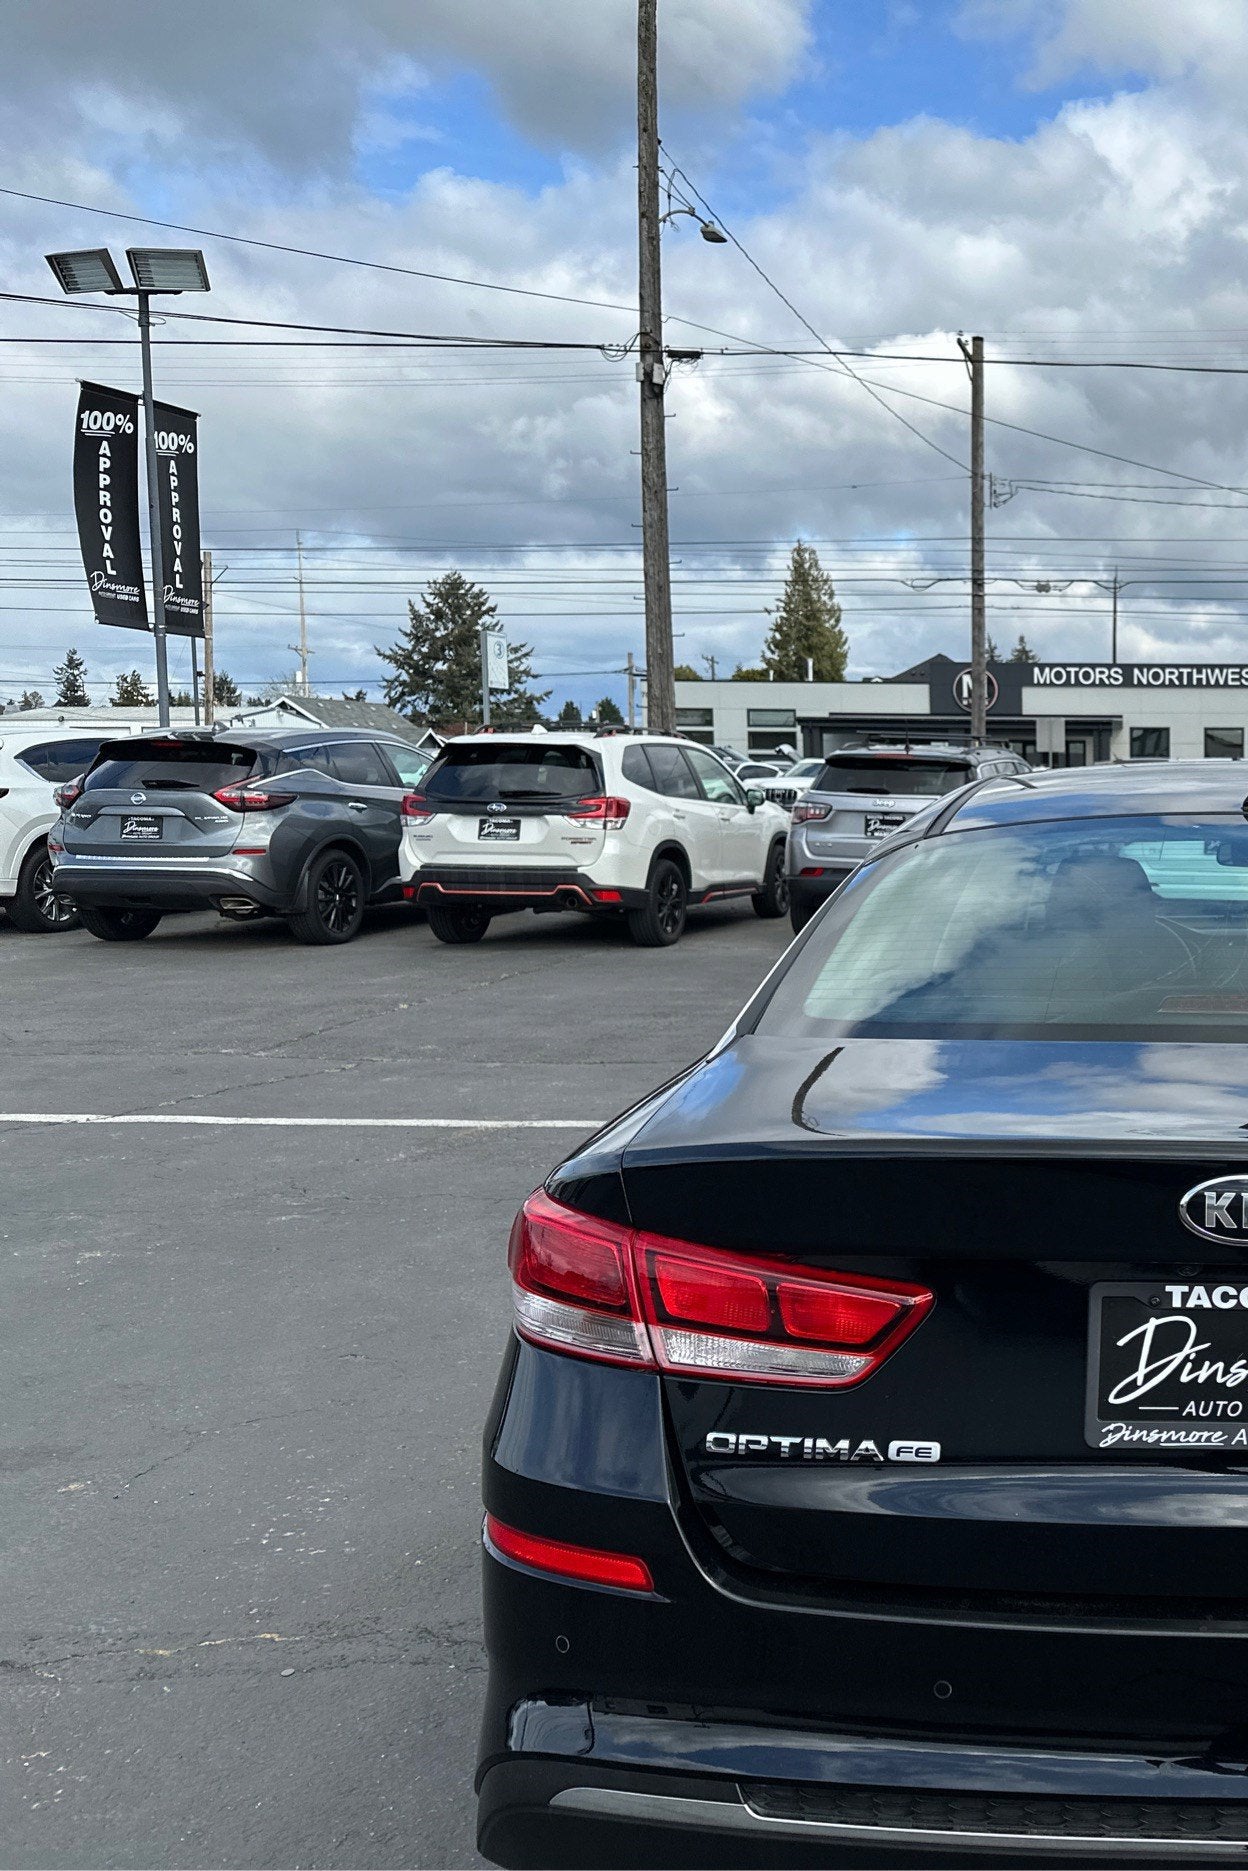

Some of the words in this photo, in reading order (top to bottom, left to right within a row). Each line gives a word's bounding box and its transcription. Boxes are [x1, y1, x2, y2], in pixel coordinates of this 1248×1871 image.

[80, 410, 134, 434] 100%
[154, 431, 195, 454] 100%
[98, 440, 117, 576] APPROVAL
[169, 460, 184, 589] APPROVAL
[90, 570, 141, 595] Dinsmore
[162, 584, 200, 608] Dinsmore
[1032, 667, 1124, 686] MOTORS
[1182, 1401, 1243, 1418] AUTO
[705, 1431, 884, 1462] OPTIMA
[895, 1446, 933, 1459] FE
[1099, 1422, 1228, 1448] Dinsmore
